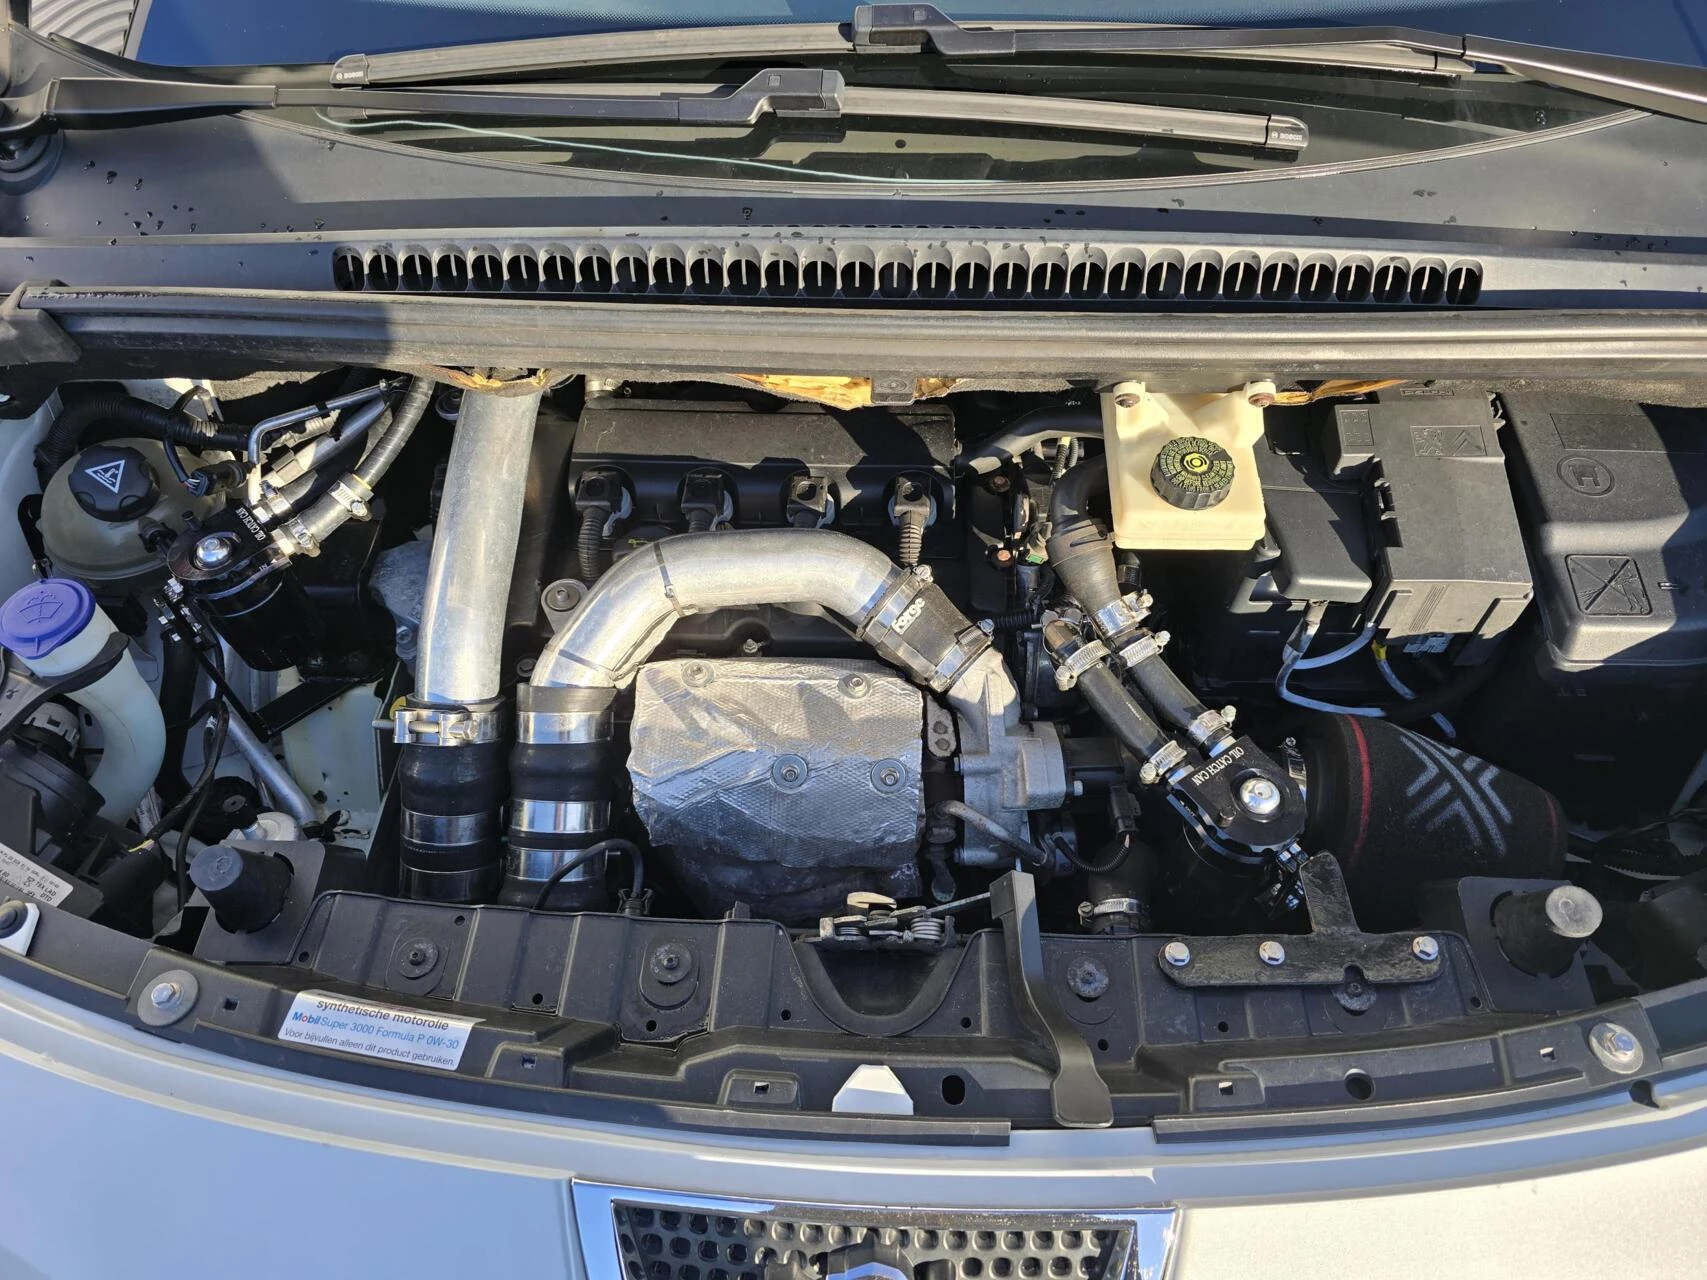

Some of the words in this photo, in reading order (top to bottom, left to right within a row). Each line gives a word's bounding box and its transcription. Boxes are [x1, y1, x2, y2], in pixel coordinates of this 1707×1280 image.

[1205, 754, 1233, 776] CATCH
[1228, 746, 1245, 759] OIL
[1191, 770, 1210, 786] CAN
[316, 1000, 390, 1020] synthetische
[392, 1013, 449, 1030] motorolie
[285, 1028, 304, 1038] Voor
[304, 1032, 338, 1046] bijvullen
[339, 1039, 364, 1050] alleen
[365, 1043, 377, 1053] dit
[377, 1046, 411, 1059] product
[350, 1022, 375, 1034] 3000
[376, 1026, 415, 1042] Formula
[417, 1033, 425, 1043] P
[426, 1035, 459, 1050] 0W-30
